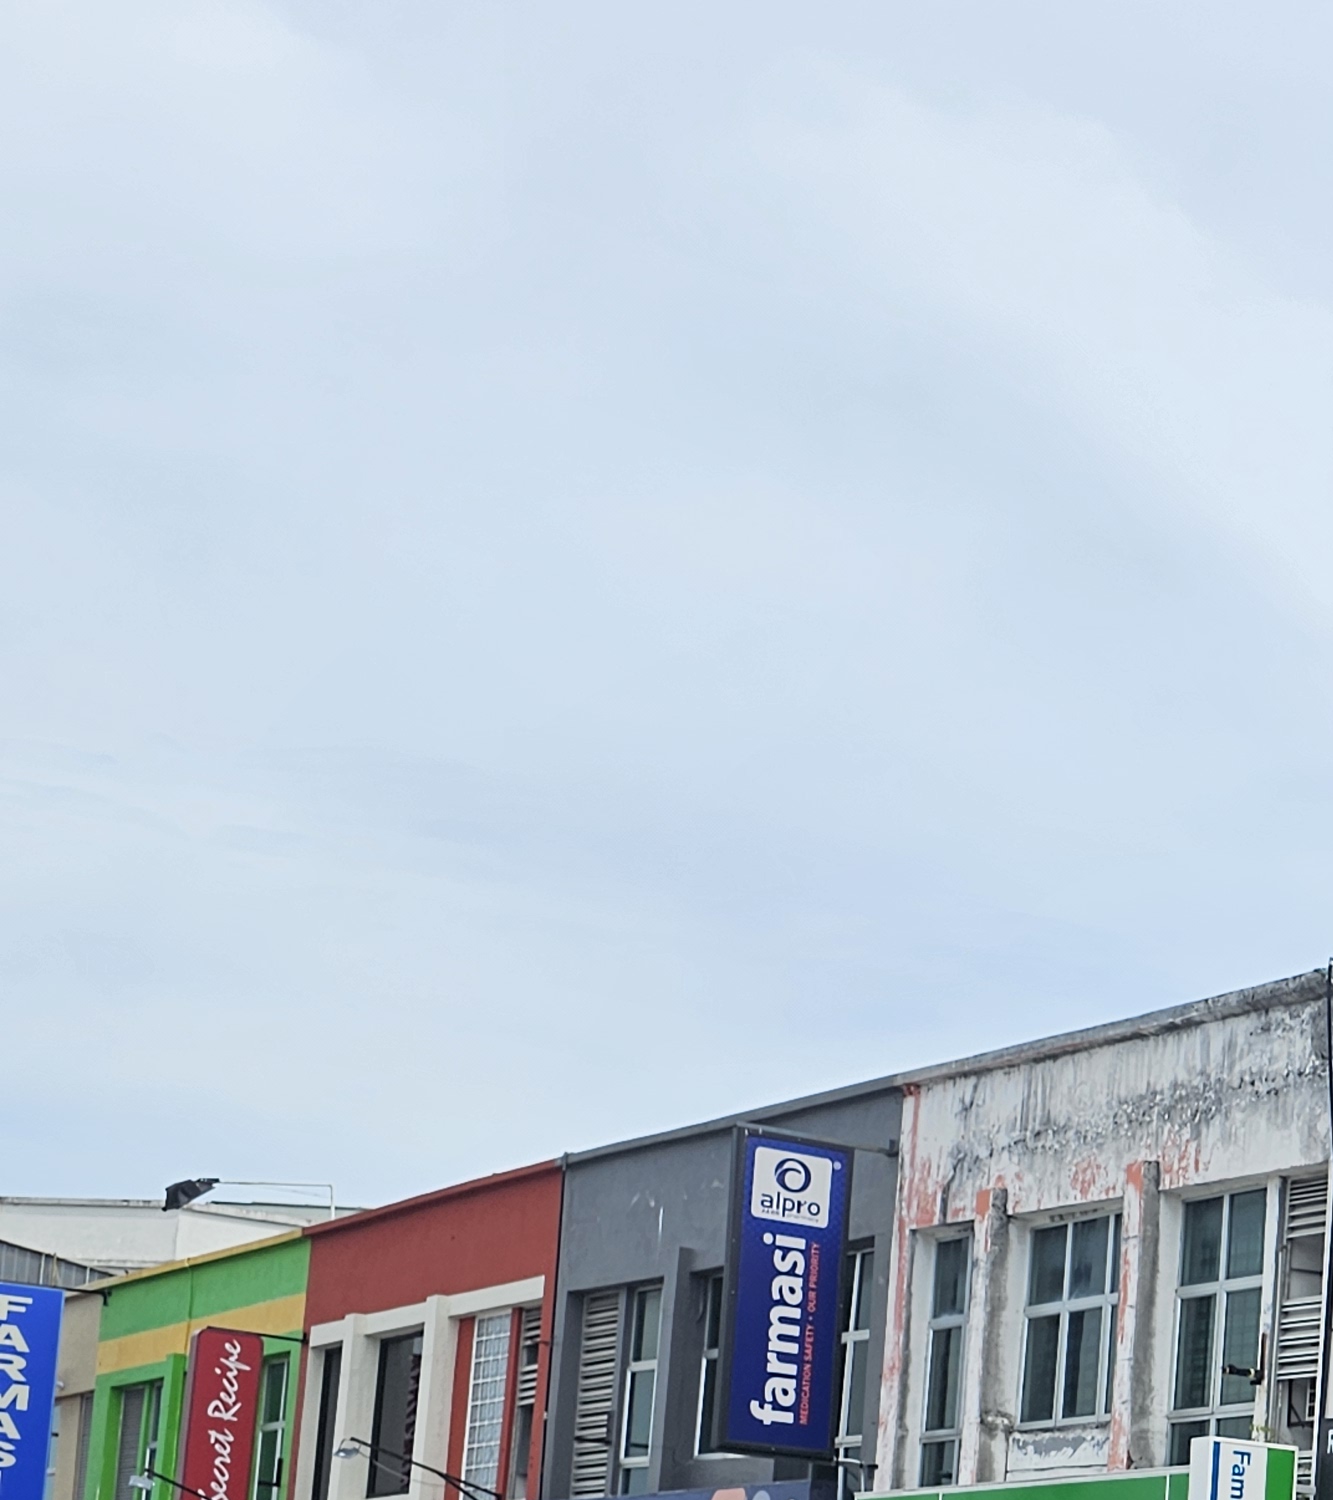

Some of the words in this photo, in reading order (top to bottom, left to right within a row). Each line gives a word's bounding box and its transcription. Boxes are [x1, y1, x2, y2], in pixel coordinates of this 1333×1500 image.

[760, 1192, 821, 1218] alpro
[809, 1242, 821, 1290] PRIORITY
[807, 1290, 818, 1312] OUR
[749, 1231, 807, 1426] farmasi
[803, 1323, 816, 1362] SAFETY
[207, 1339, 252, 1423] Recipe
[799, 1363, 813, 1426] MEDICATION
